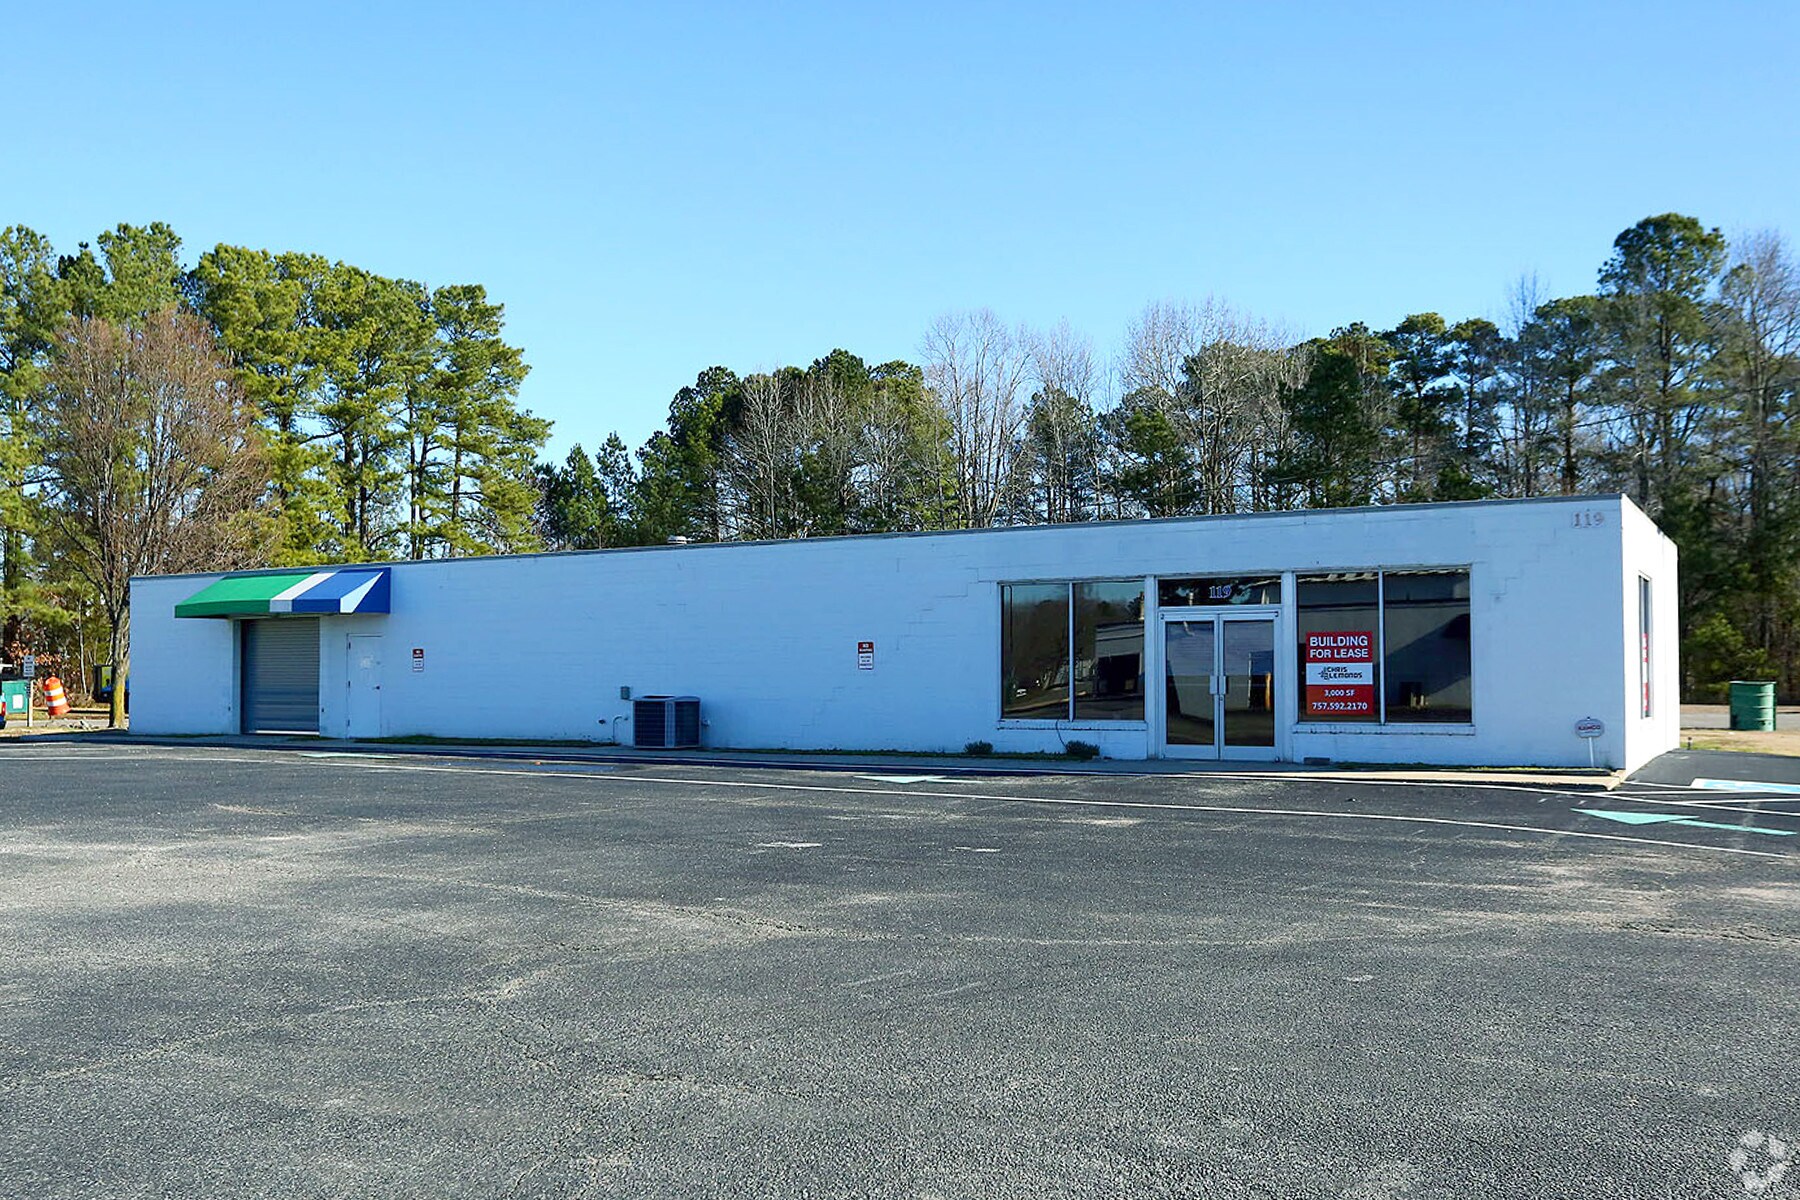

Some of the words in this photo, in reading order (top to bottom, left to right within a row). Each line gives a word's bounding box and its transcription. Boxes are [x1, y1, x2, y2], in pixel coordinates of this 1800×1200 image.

[1573, 511, 1604, 528] 119
[1209, 585, 1231, 599] 119
[1309, 636, 1368, 647] BUILDING
[1309, 649, 1331, 658] FOR
[1334, 648, 1369, 658] LEASE
[1324, 689, 1345, 697] 3,000
[1345, 689, 1356, 697] SF
[1312, 702, 1368, 711] 757.592.2170
